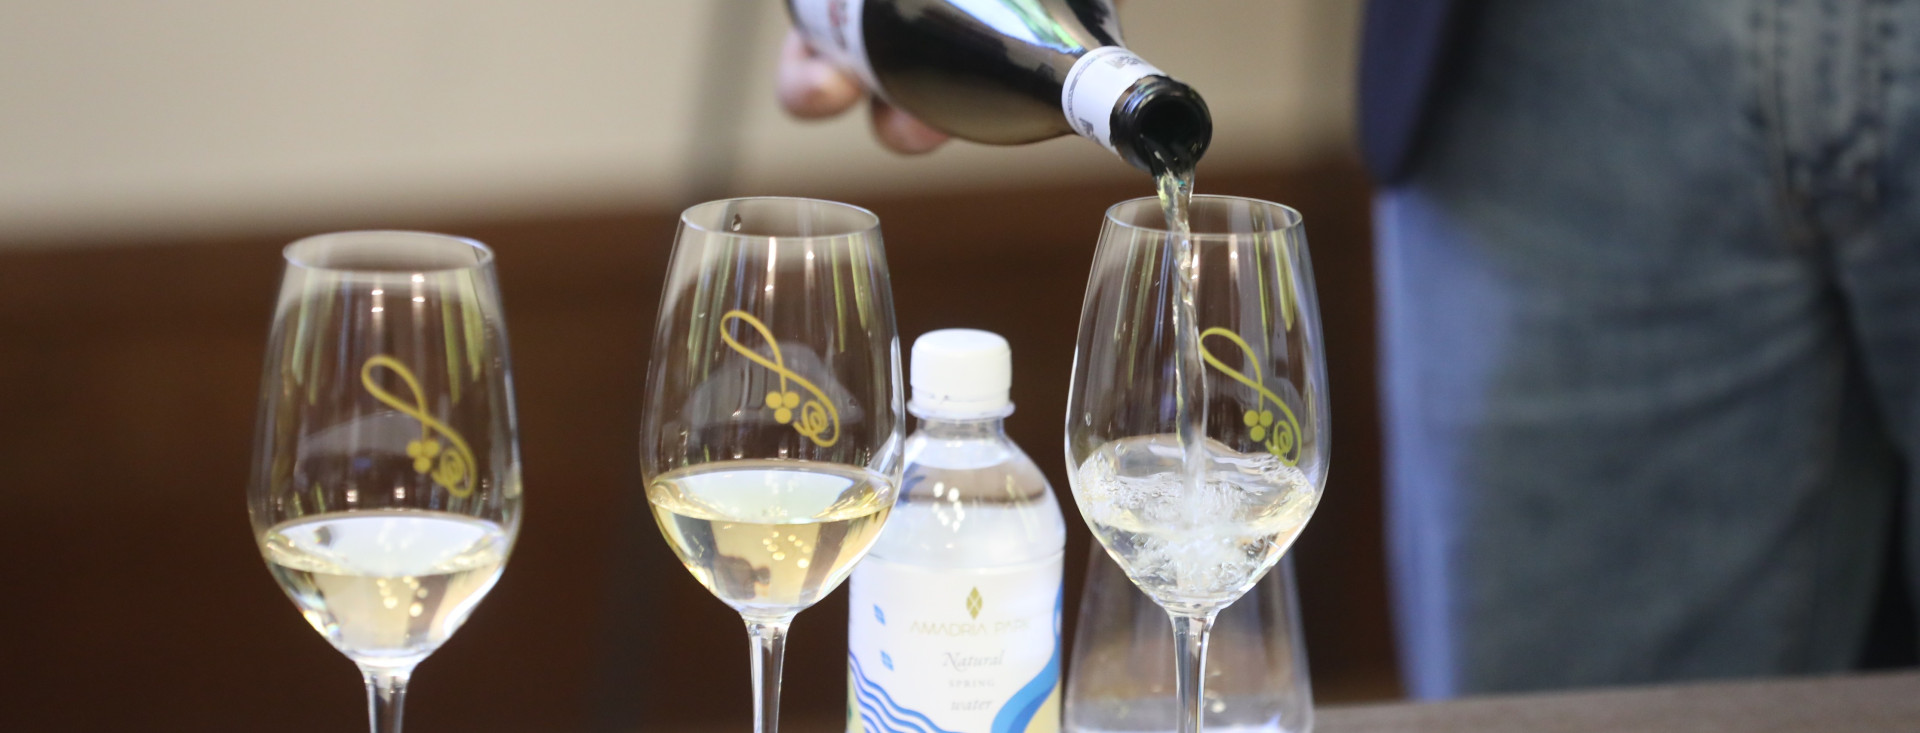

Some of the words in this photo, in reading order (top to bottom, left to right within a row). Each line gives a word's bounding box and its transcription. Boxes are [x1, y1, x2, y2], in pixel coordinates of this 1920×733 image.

[910, 619, 987, 637] AMADRIA
[942, 649, 1005, 672] Natural
[948, 679, 995, 689] SPRING
[951, 698, 992, 711] water
